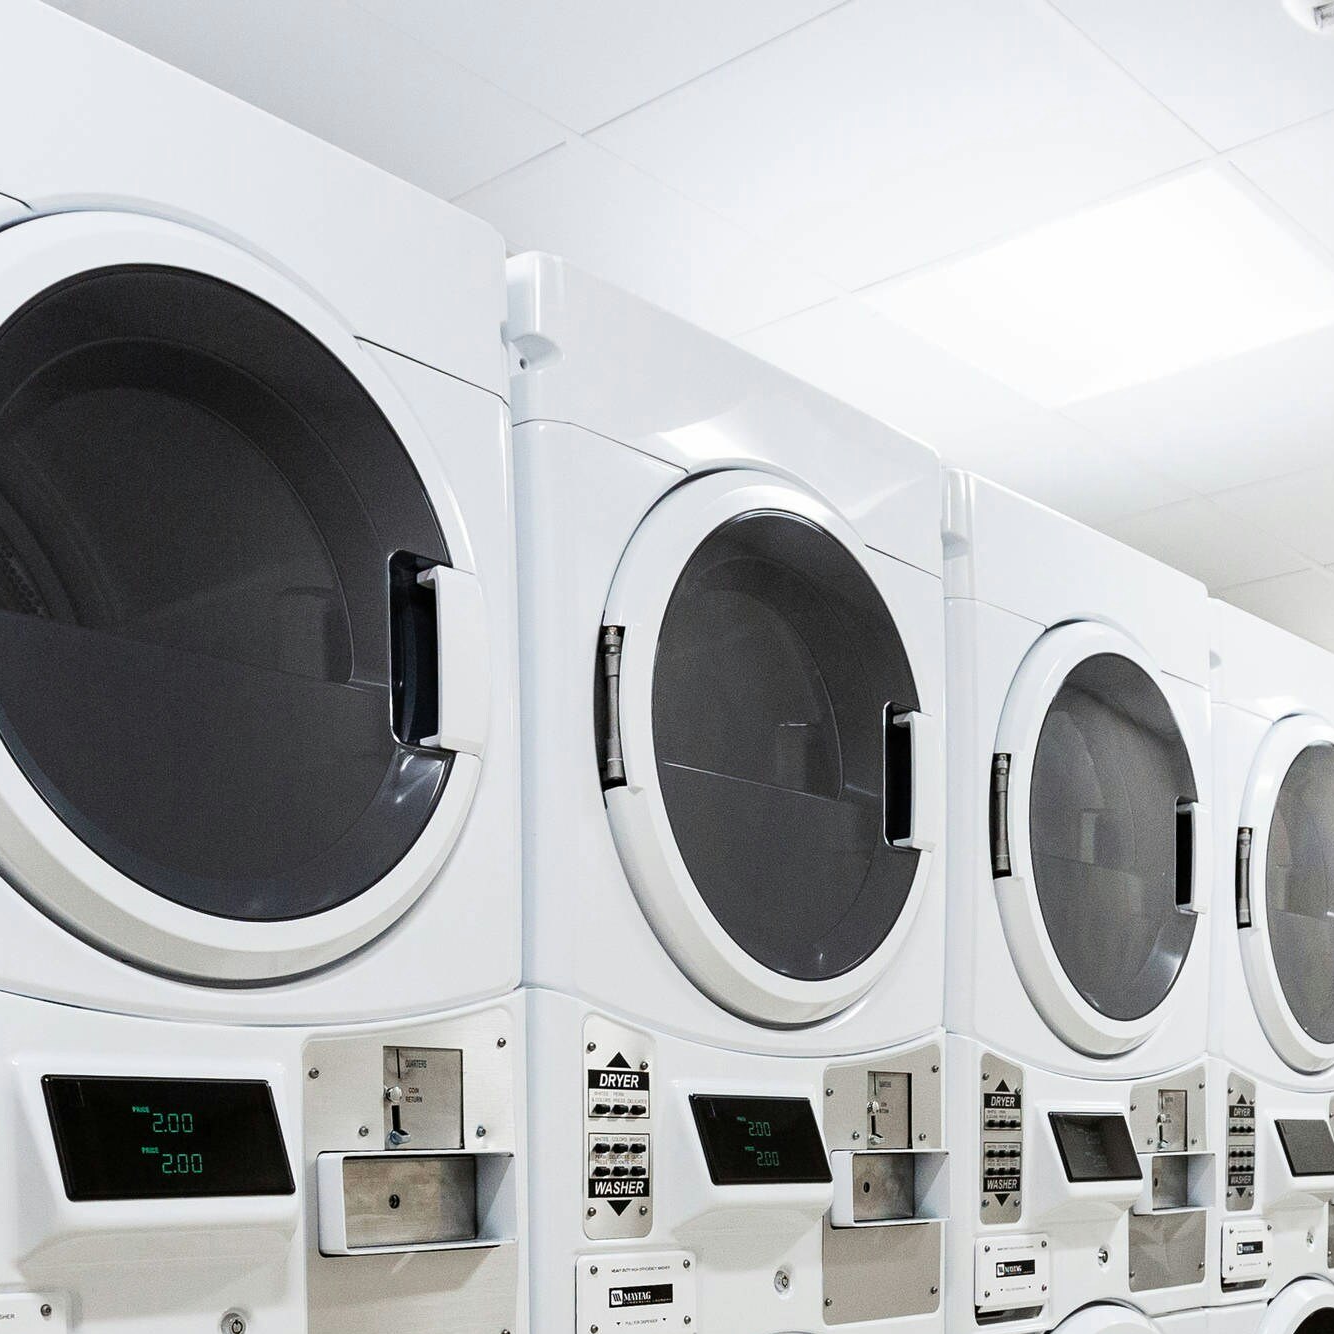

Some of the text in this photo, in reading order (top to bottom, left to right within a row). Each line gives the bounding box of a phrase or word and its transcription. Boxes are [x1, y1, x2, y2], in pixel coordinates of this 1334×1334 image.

[599, 1073, 639, 1088] DRYER
[990, 1096, 1015, 1107] DRYER
[152, 1113, 193, 1132] 2.00
[162, 1154, 203, 1173] 2.00
[595, 1181, 644, 1195] WASHER
[987, 1179, 1017, 1190] WASHER
[624, 1291, 651, 1301] MAYTAG
